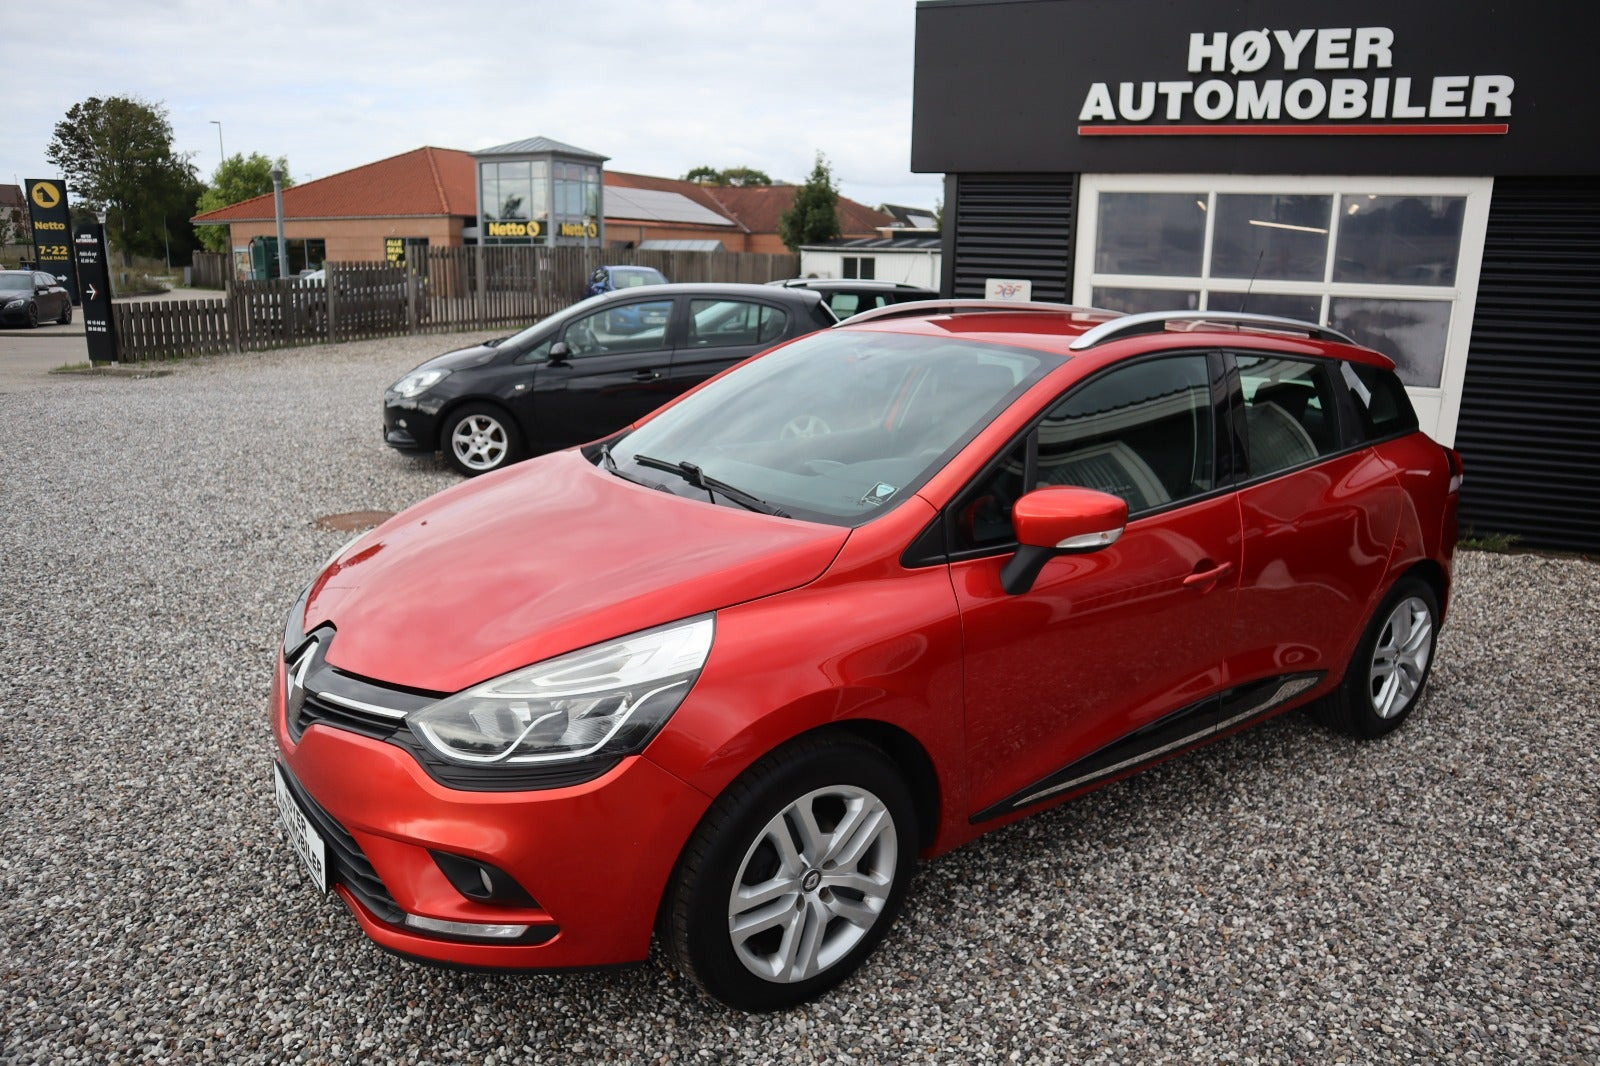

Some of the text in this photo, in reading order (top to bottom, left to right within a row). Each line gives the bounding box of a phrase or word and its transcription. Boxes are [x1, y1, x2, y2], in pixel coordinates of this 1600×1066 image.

[1187, 27, 1394, 75] HØYER
[1078, 75, 1515, 120] AUTOMOBILER
[35, 221, 65, 230] Netto
[488, 222, 526, 236] Netto
[39, 245, 68, 255] 7-22
